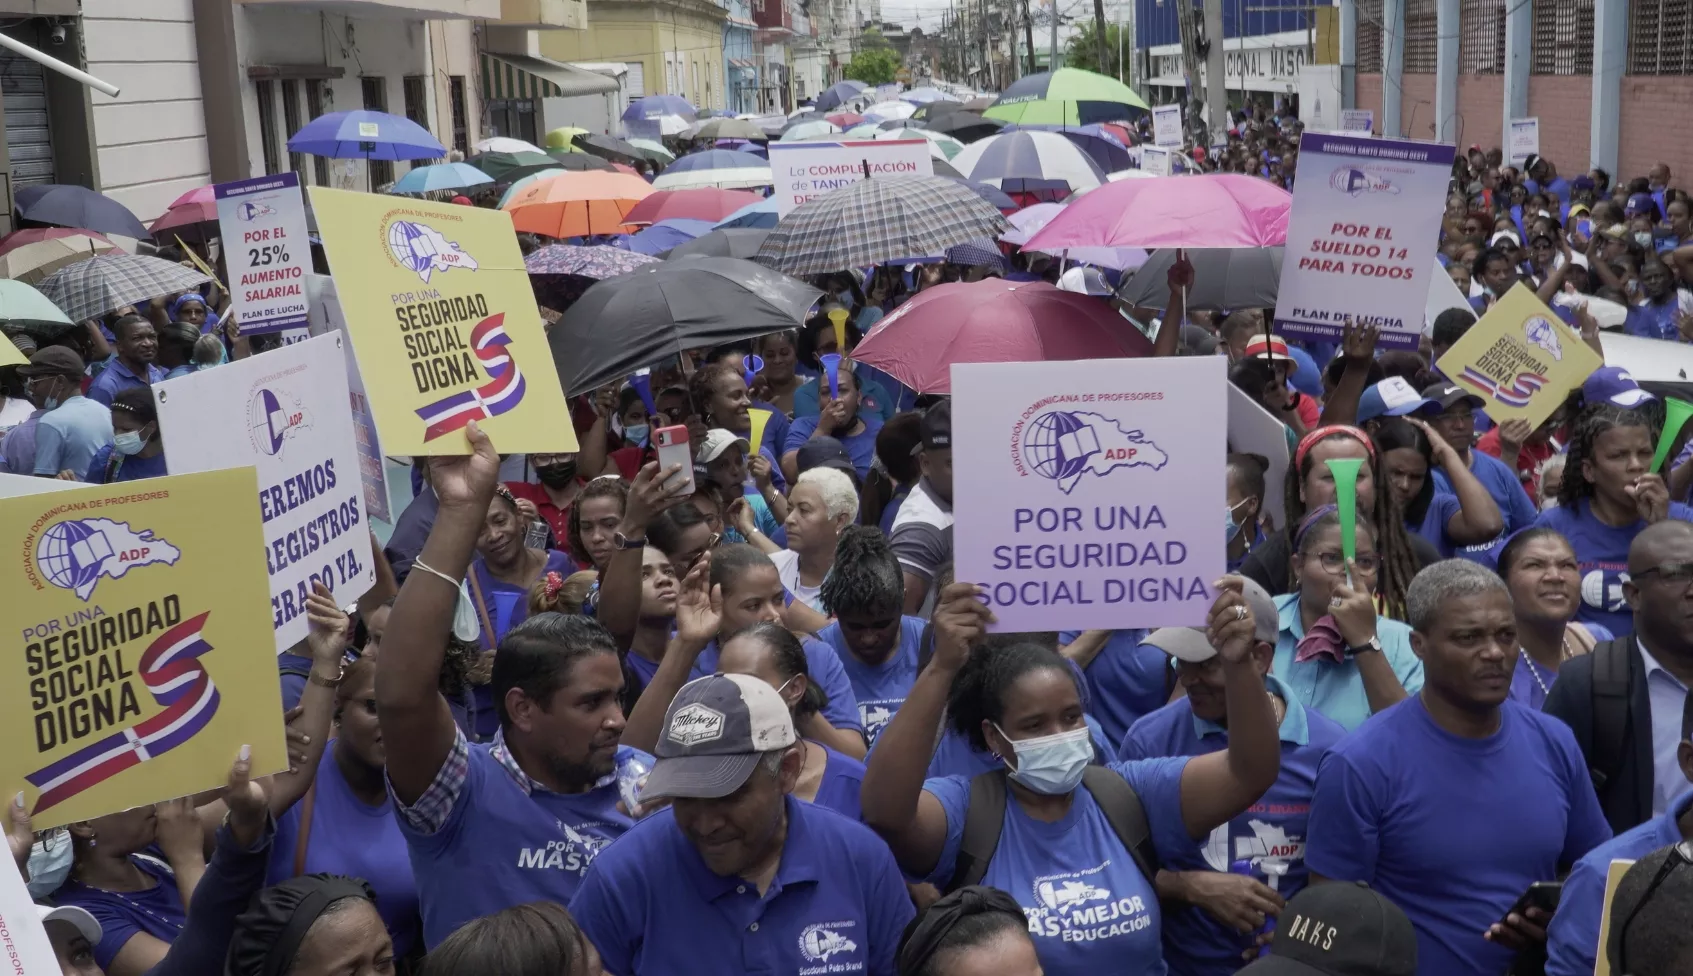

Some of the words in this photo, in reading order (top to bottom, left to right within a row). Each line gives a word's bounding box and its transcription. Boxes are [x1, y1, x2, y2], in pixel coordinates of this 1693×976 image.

[1162, 55, 1179, 76] GRAN
[1227, 52, 1265, 76] CIONAL
[789, 166, 805, 177] La
[809, 159, 917, 176] COMPLETACIÓN
[791, 180, 808, 191] de
[244, 229, 270, 244] POR
[273, 226, 287, 239] EL
[1330, 222, 1370, 238] POR
[1374, 227, 1393, 241] EL
[248, 243, 290, 267] 25%
[441, 253, 460, 263] ADP
[1310, 239, 1381, 258] SUELDO
[1387, 247, 1409, 261] 14
[240, 266, 302, 286] AUMENTO
[1298, 257, 1345, 274] PARA
[1351, 262, 1414, 281] TODOS
[245, 283, 302, 302] SALARIAL
[391, 291, 416, 305] POR
[416, 288, 441, 301] UNA
[242, 310, 262, 319] PLAN
[264, 308, 275, 316] DE
[277, 304, 305, 315] LUCHA
[395, 293, 489, 332] SEGURIDAD
[1292, 308, 1330, 320] PLAN
[403, 325, 468, 360] SOCIAL
[1486, 346, 1521, 374] SOCIAL
[1495, 337, 1548, 376] SEGURIDAD
[411, 351, 479, 393] DIGNA
[1475, 355, 1513, 385] DIGNA
[289, 412, 303, 427] ADP
[1011, 420, 1029, 478] ASOCIACIÓN
[1022, 395, 1079, 420] DOMINICANA
[1082, 393, 1095, 403] DE
[1098, 392, 1164, 402] PROFESORES
[1104, 448, 1137, 460] ADP
[105, 490, 169, 507] PROFESORES
[259, 458, 337, 523] EREMOS
[89, 500, 103, 509] DE
[30, 502, 88, 533] DOMINICANA
[1014, 507, 1083, 533] POR
[1095, 505, 1167, 531] UNA
[264, 494, 360, 576] REGISTROS
[23, 533, 45, 592] ASOCIACIÓN
[118, 547, 151, 563] ADP
[335, 548, 363, 586] YA.
[992, 541, 1188, 570] SEGURIDAD
[975, 579, 1094, 607] SOCIAL
[1103, 576, 1210, 604] DIGNA
[22, 619, 62, 643] POR
[65, 604, 106, 628] UNA
[25, 594, 181, 677] SEGURIDAD
[30, 648, 133, 711] SOCIAL
[34, 680, 141, 753] DIGNA
[546, 840, 575, 853] POR
[1270, 844, 1299, 857] ADP
[1079, 890, 1096, 899] ADP
[1022, 907, 1049, 918] POR
[1060, 918, 1072, 929] Y
[1072, 895, 1146, 926] MEJOR
[1062, 914, 1152, 942] EDUCACIÓN
[1288, 914, 1337, 951] DAKS
[845, 961, 863, 971] Brand
